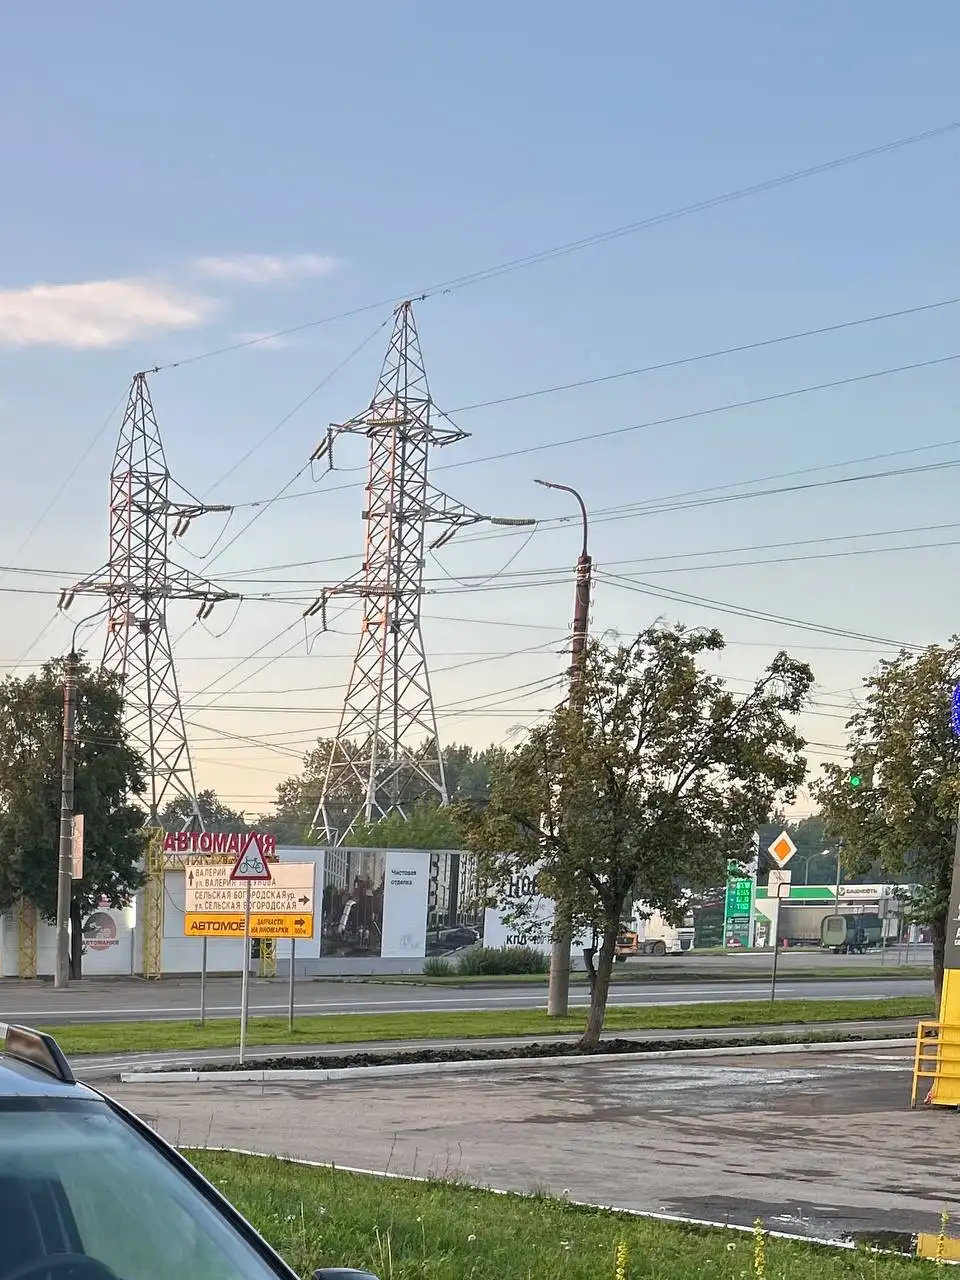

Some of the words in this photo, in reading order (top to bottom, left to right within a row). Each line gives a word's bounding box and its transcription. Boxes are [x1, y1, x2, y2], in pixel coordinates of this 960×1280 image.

[194, 891, 232, 900] СЕЛЬСКАЯ
[233, 890, 286, 900] БОГРОДСКАЯ
[204, 901, 241, 910] СЕЛЬСКАЯ
